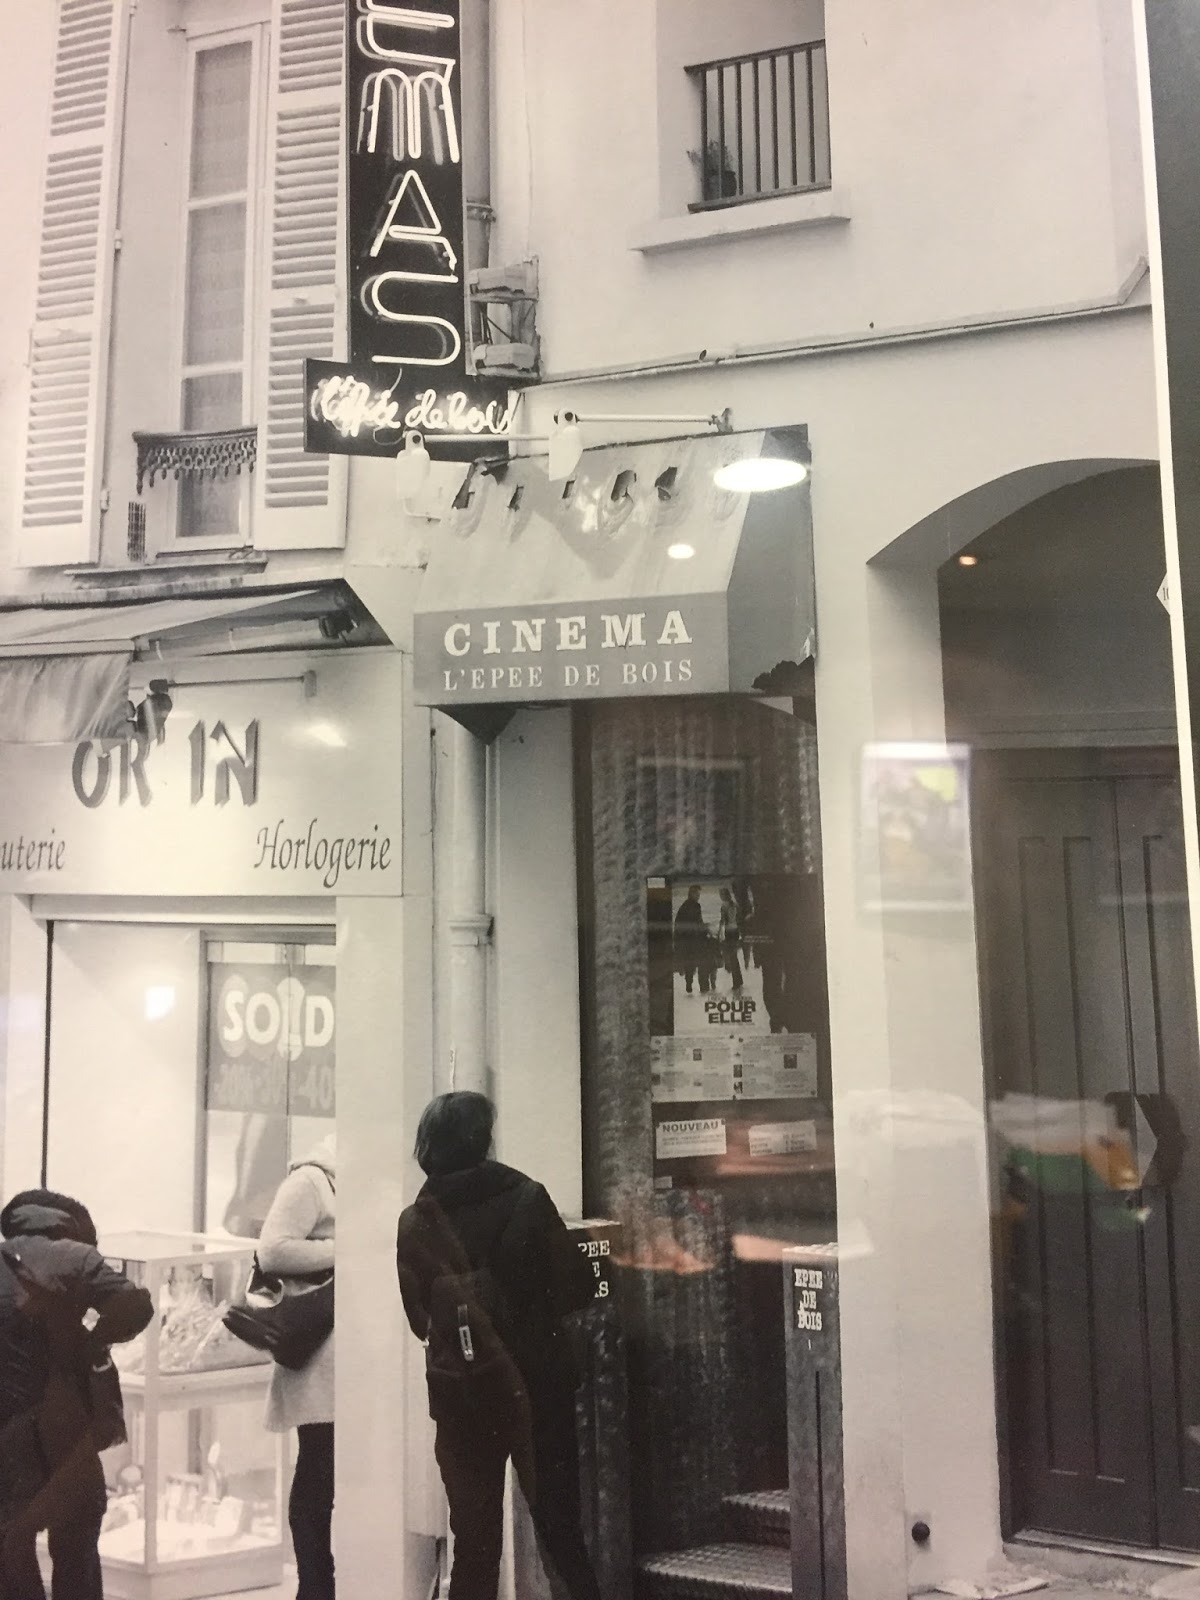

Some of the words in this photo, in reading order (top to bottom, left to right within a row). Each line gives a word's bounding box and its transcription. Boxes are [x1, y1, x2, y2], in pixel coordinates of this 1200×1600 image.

[443, 609, 693, 657] CINEMA
[443, 666, 543, 691] L'EPEE
[564, 664, 600, 687] DE
[622, 658, 693, 685] BOIS
[253, 818, 392, 889] Horlogerie
[704, 1000, 757, 1013] POUR
[708, 1012, 753, 1024] ELLE
[662, 1120, 719, 1133] NOUVEAU
[794, 1268, 823, 1289] EPEE
[802, 1289, 817, 1309] DE
[797, 1308, 823, 1331] BOIS
